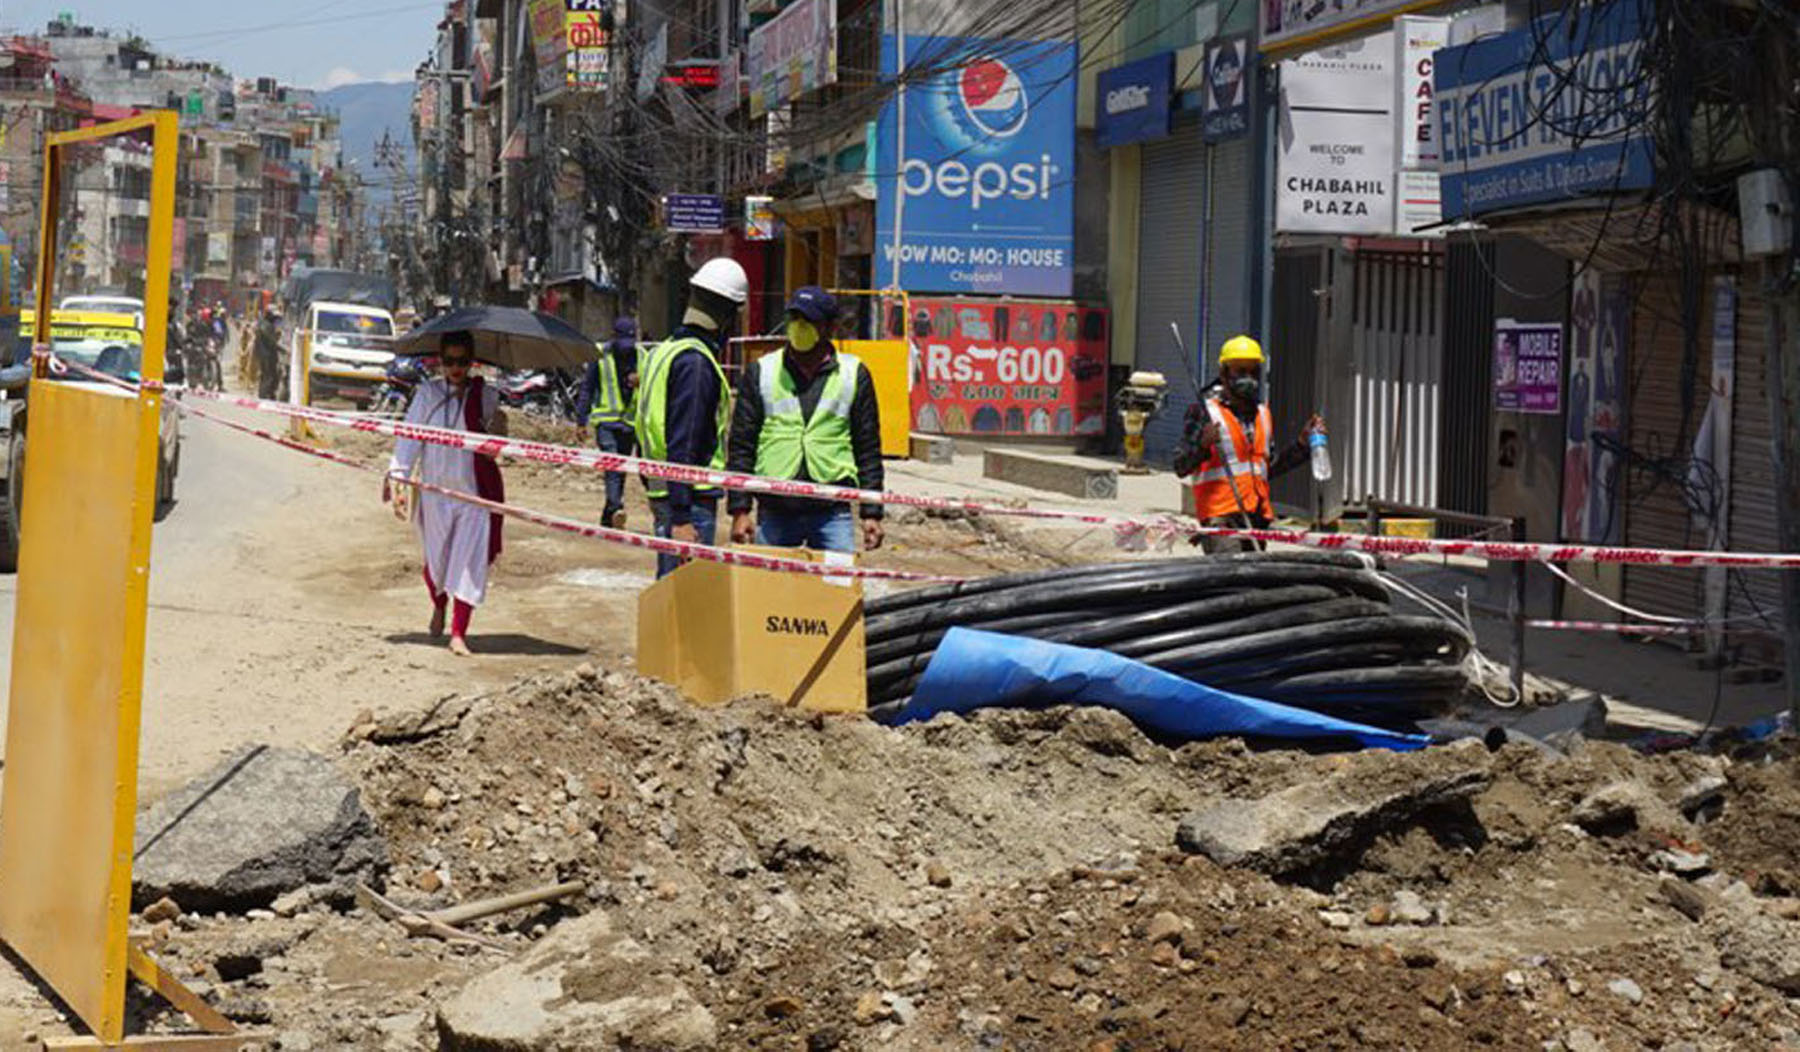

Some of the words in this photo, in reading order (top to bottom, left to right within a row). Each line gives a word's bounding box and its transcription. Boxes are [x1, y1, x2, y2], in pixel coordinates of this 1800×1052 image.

[1415, 59, 1434, 142] CAFE
[1439, 81, 1529, 162] ELEVEN
[1309, 144, 1364, 155] WELCOME
[1330, 156, 1345, 166] TO
[900, 154, 1051, 209] pepsi
[1286, 177, 1386, 195] CHABAHIL
[1302, 199, 1369, 216] PLAZA
[884, 244, 929, 263] WOW
[931, 245, 966, 264] MO:
[969, 247, 1003, 265] MO:
[1007, 248, 1064, 267] HOUSE
[949, 270, 1003, 283] Chabahil
[1518, 333, 1560, 356] MOBILE
[997, 346, 1065, 384] 600
[1517, 359, 1559, 385] REPAIR
[766, 615, 830, 637] SANWA
